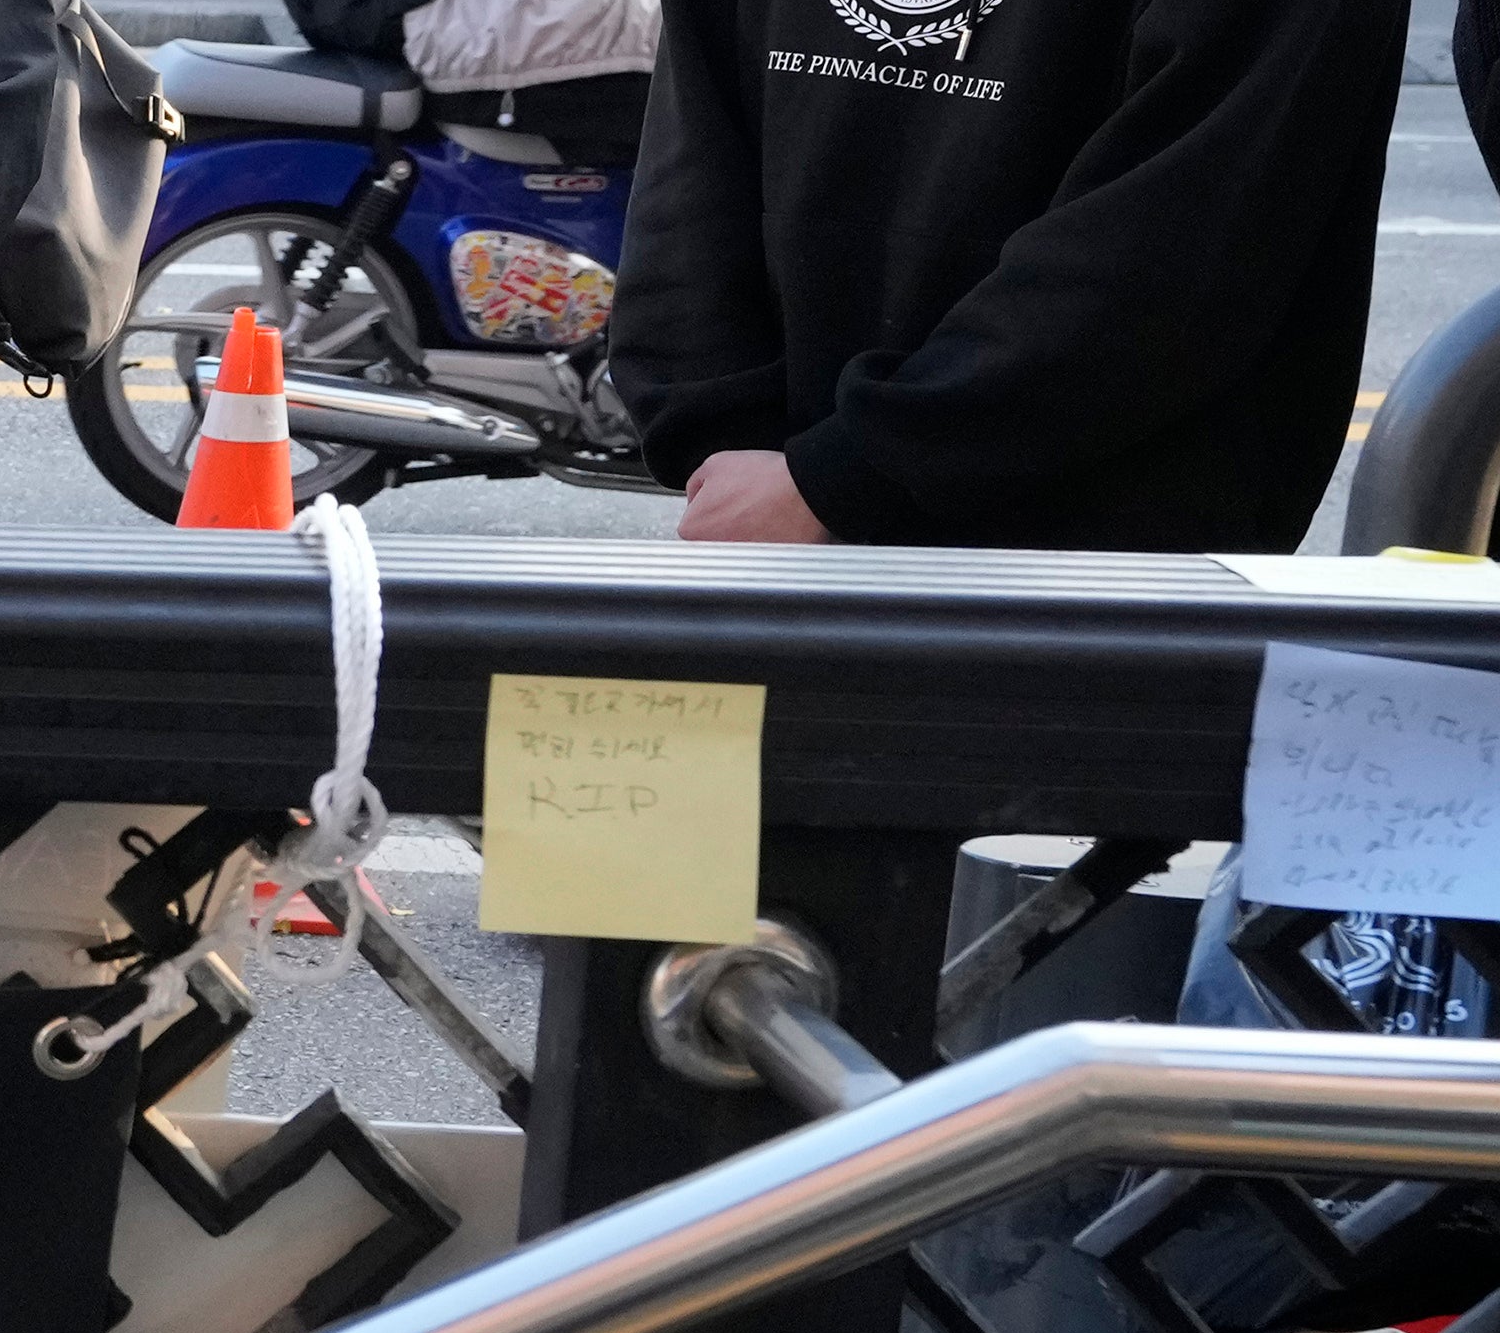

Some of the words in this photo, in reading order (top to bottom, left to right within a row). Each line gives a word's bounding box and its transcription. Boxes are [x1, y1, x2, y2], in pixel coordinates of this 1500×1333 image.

[767, 50, 805, 74] THE
[808, 54, 928, 91] PINNACLE
[932, 72, 962, 96] OF
[962, 76, 1006, 102] LIFE
